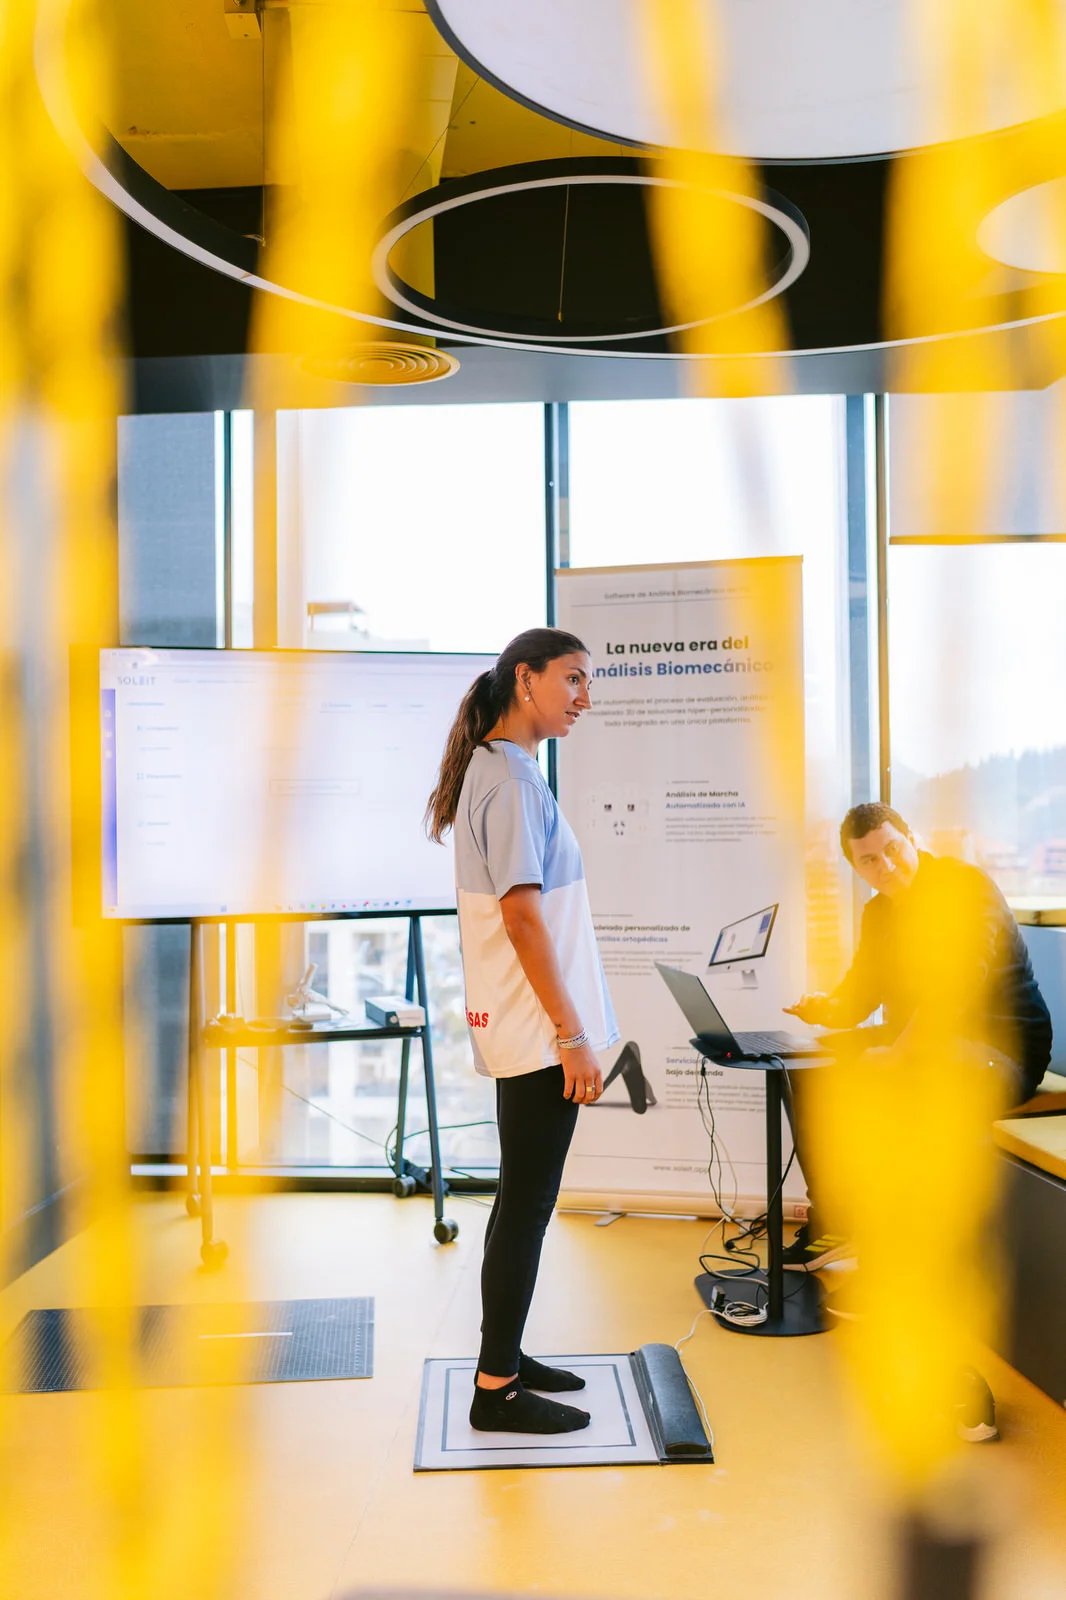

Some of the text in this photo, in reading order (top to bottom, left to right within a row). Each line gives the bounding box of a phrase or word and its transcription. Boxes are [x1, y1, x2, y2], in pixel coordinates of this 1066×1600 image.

[606, 635, 749, 655] La nueva era del
[591, 658, 774, 678] nálisis Biomecánico
[665, 790, 739, 799] Análisis de Marcha
[593, 924, 623, 932] odelado
[465, 1009, 489, 1028] SAS
